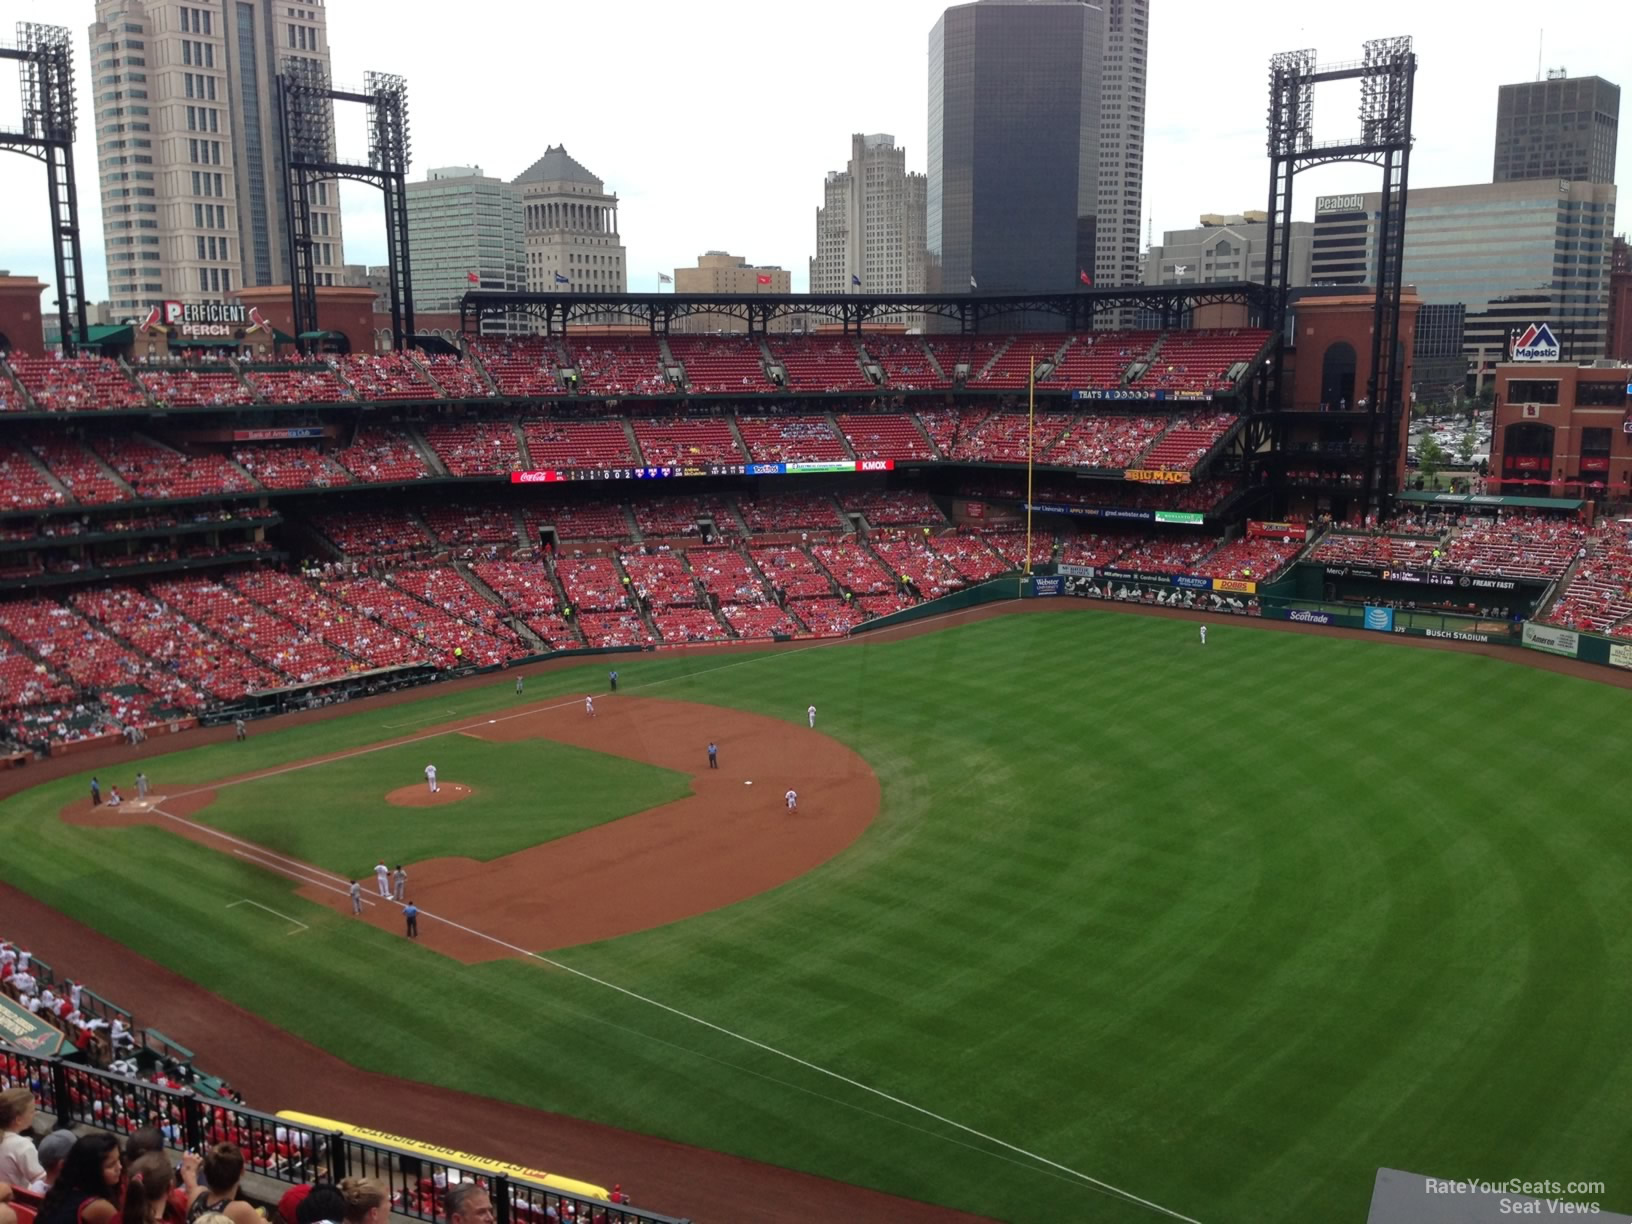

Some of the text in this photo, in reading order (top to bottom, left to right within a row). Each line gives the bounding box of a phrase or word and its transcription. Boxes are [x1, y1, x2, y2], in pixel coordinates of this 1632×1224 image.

[1318, 195, 1363, 210] Peabody
[164, 300, 245, 324] PERFICIENT
[182, 325, 230, 335] PERCH
[1516, 348, 1557, 359] Majestic
[1079, 391, 1101, 399] THAT'S
[862, 461, 886, 470] KMOX
[1132, 471, 1182, 482] BIG MAC
[1105, 510, 1150, 519] grad.webster.edu
[1326, 567, 1344, 576] Mercy
[1383, 570, 1390, 579] P
[1221, 581, 1247, 590] DOBBS
[1472, 580, 1515, 589] FREAKY FAST!
[1290, 610, 1328, 624] Scottrade
[1426, 629, 1488, 642] BUSCH STADIUM
[1532, 634, 1555, 646] Ameren
